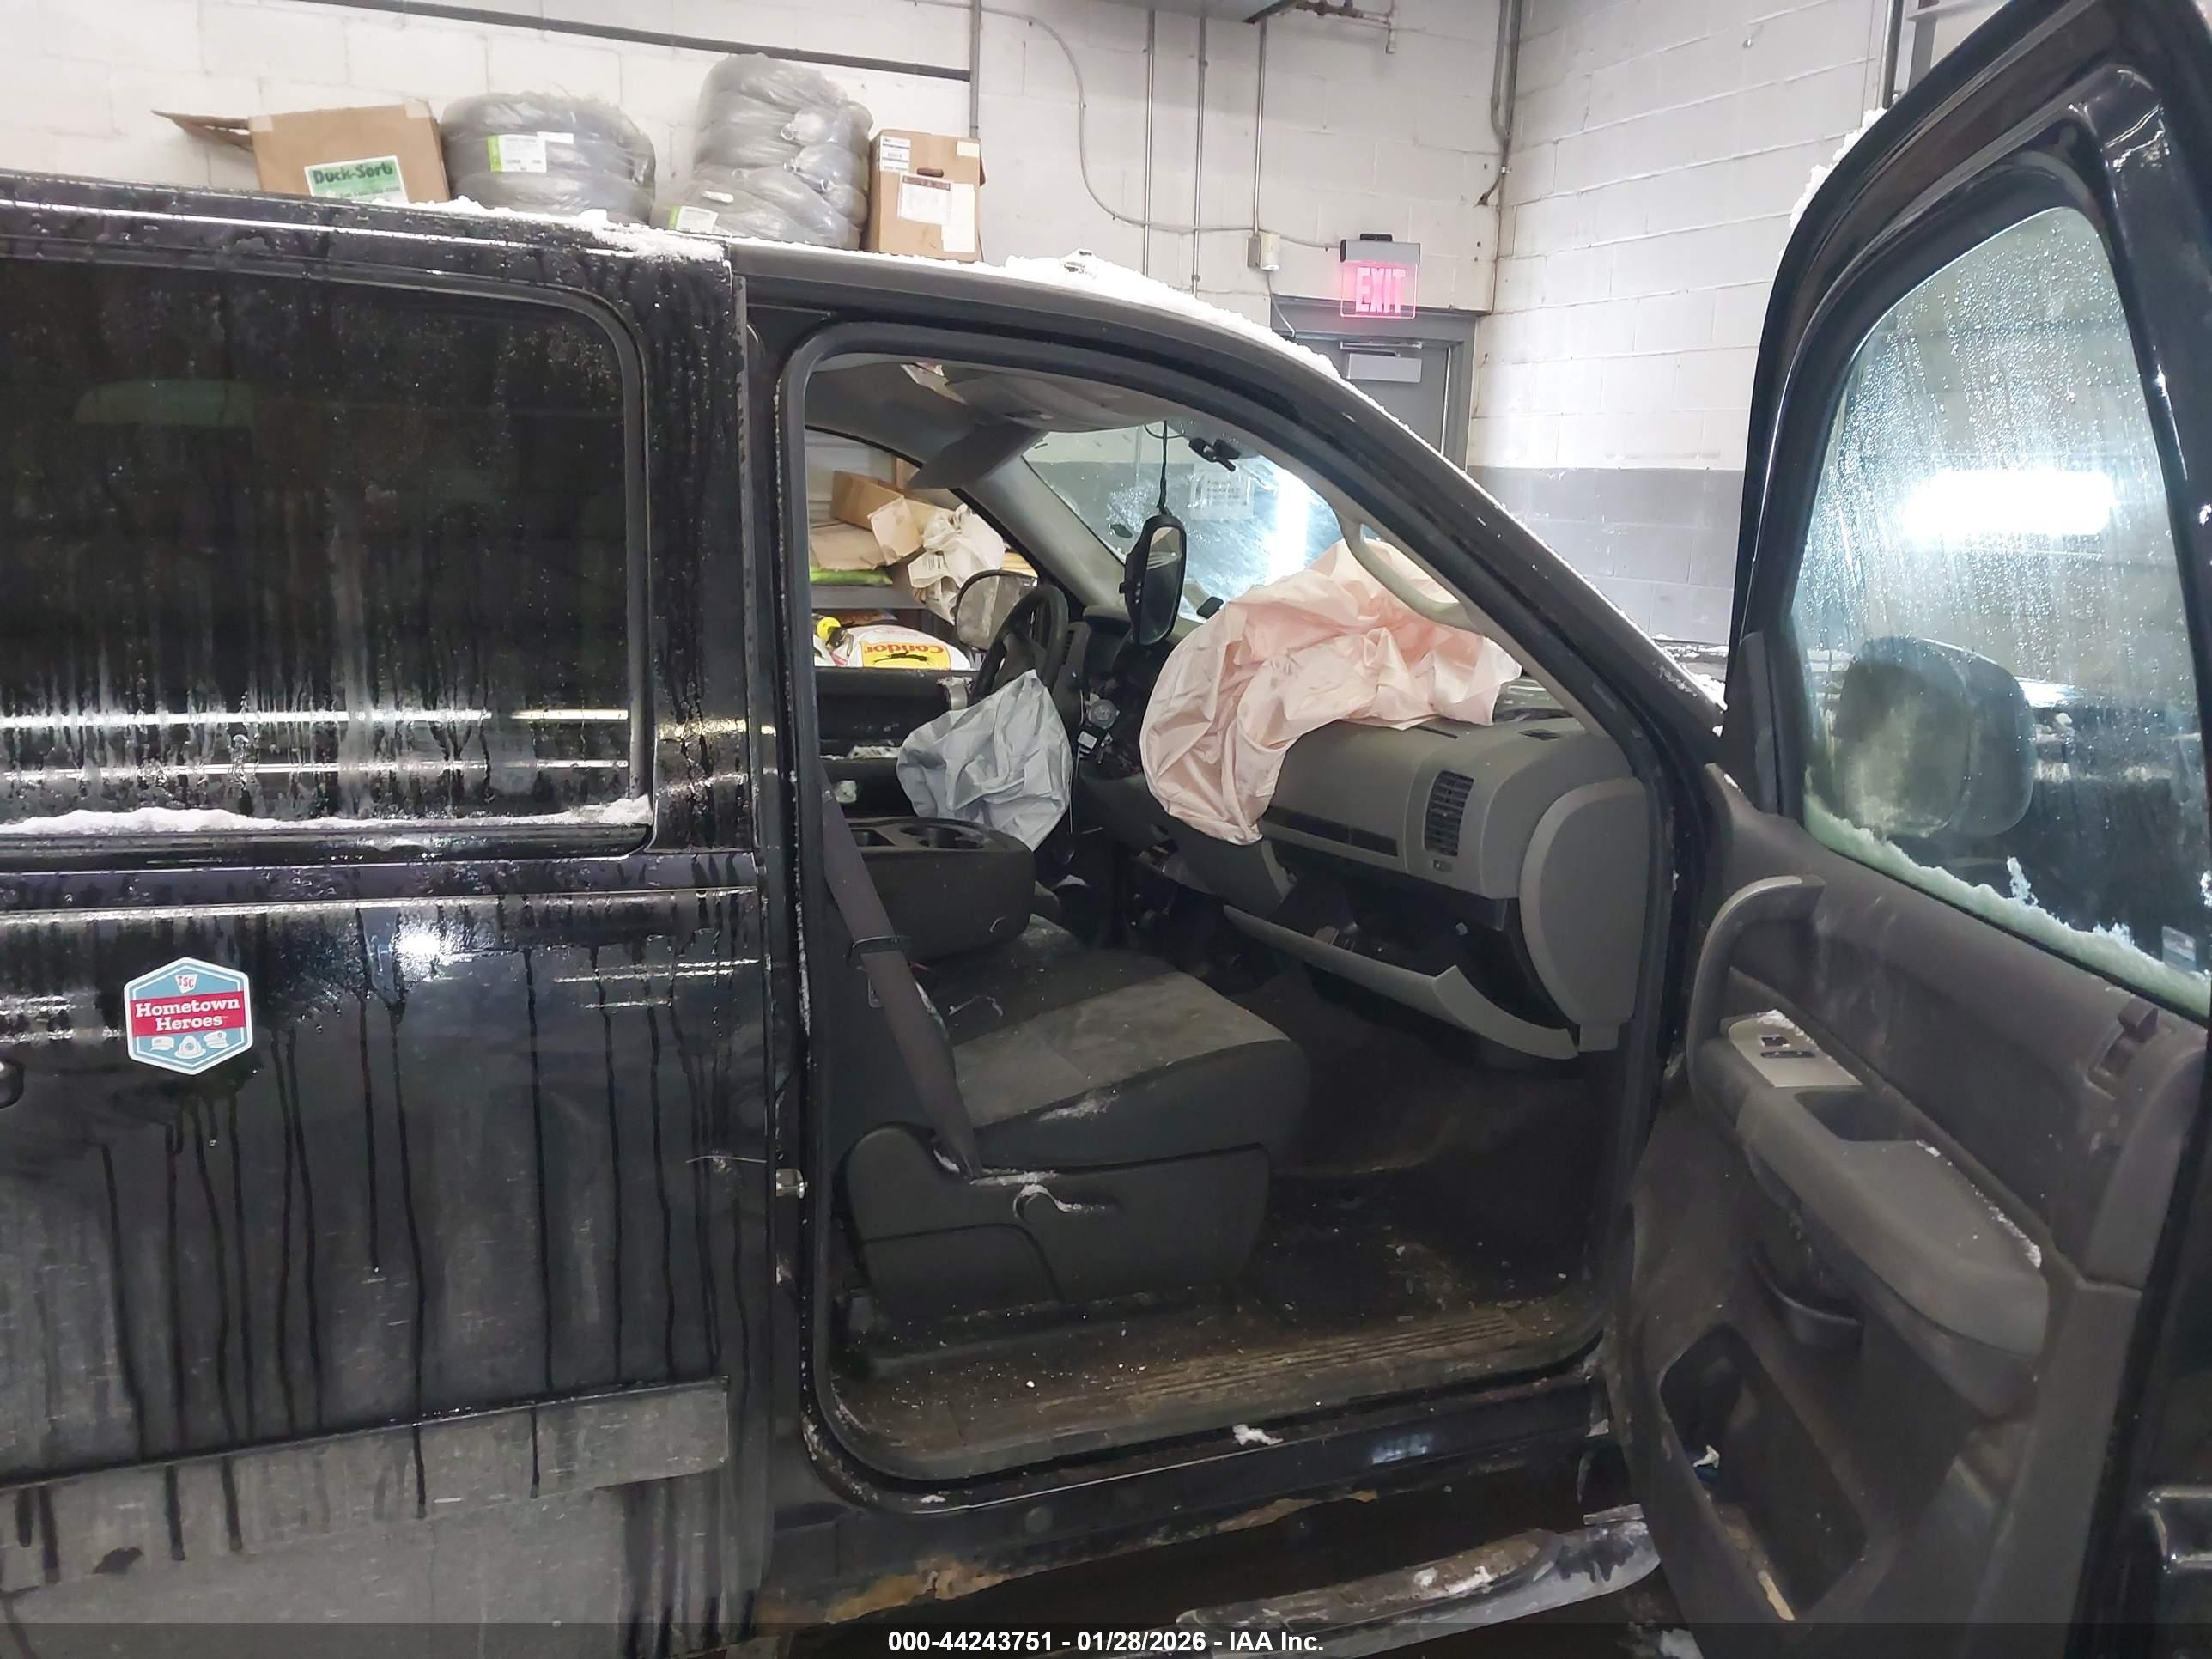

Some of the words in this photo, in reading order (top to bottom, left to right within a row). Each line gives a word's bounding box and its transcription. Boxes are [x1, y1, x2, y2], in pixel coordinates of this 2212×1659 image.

[312, 162, 393, 185] Duck-Sorb
[1355, 266, 1406, 314] EXIT
[865, 643, 944, 654] Condor
[178, 975, 195, 989] TSC
[136, 998, 240, 1018] Hometown
[155, 1015, 223, 1032] Heroes
